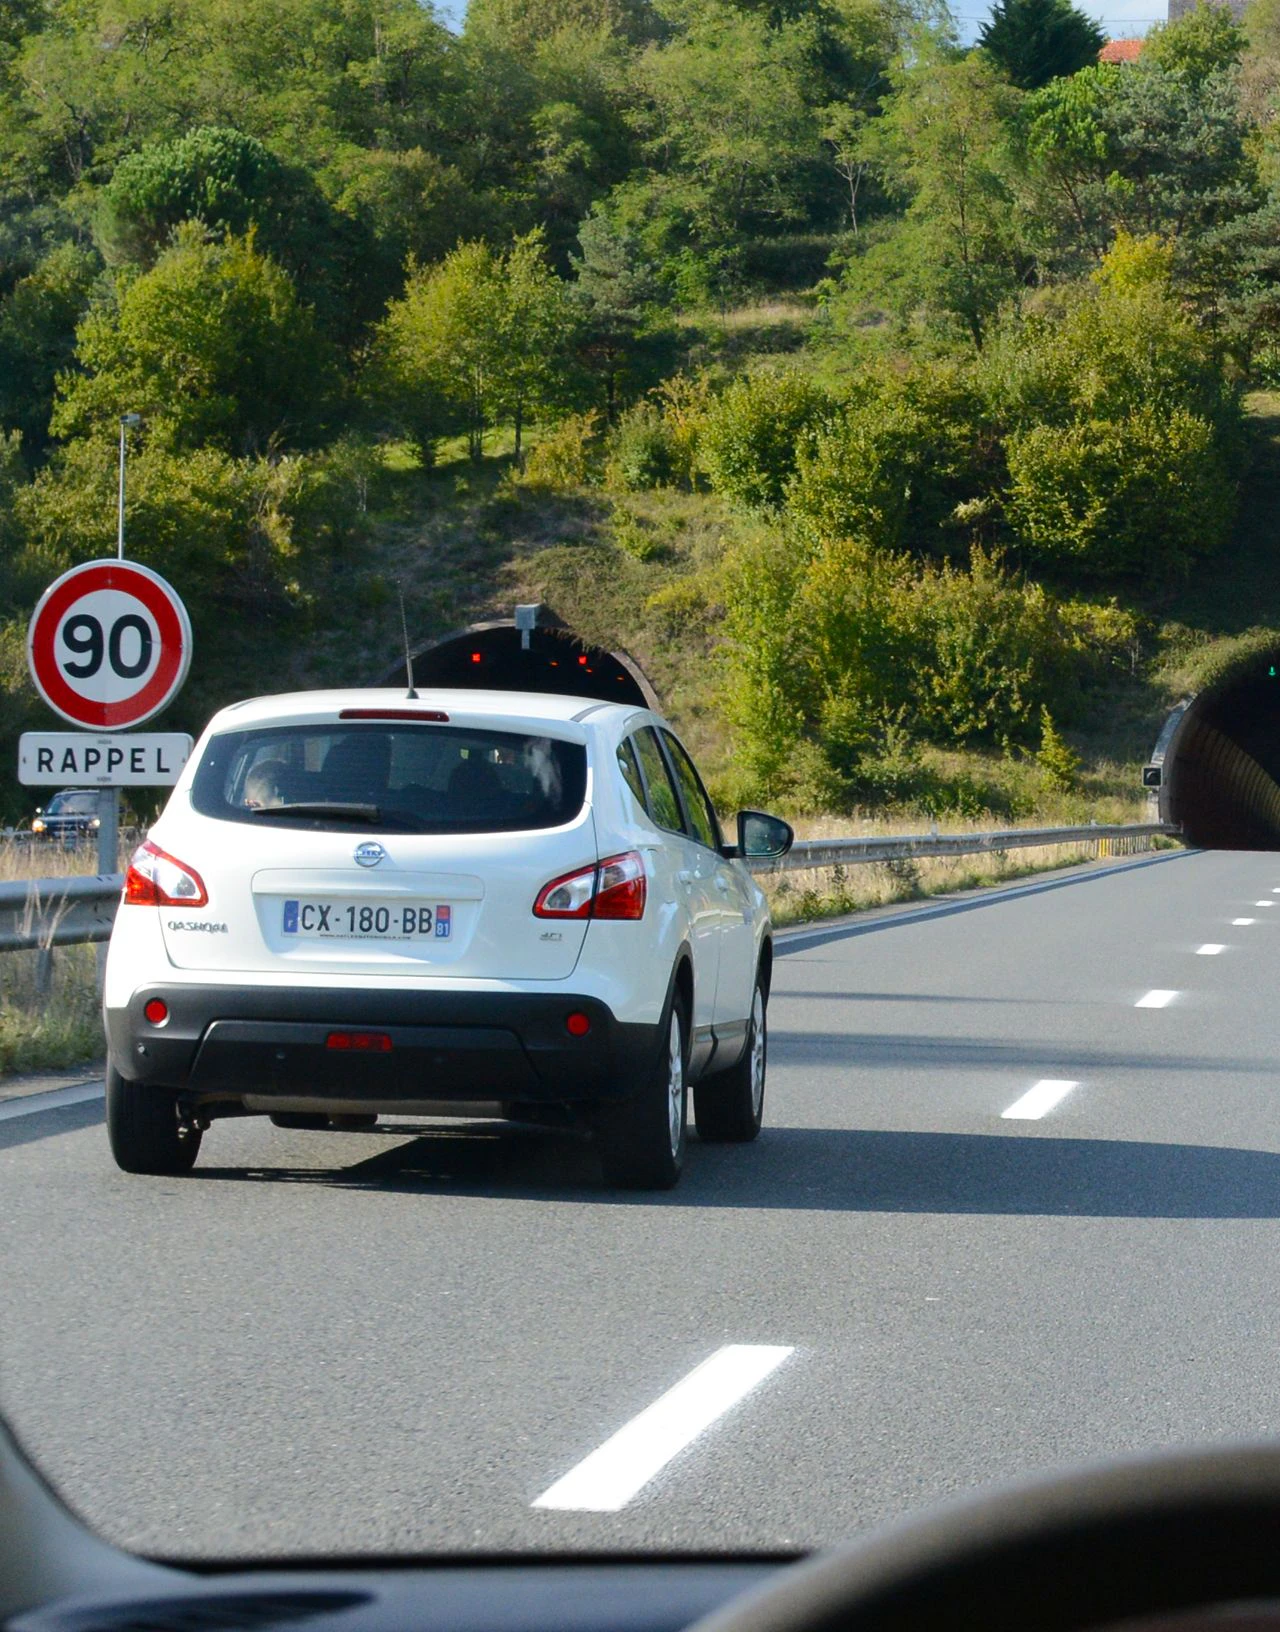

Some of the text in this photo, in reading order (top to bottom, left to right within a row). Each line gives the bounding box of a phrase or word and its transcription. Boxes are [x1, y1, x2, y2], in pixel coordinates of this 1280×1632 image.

[62, 613, 153, 679] 90
[37, 747, 171, 773] RAPPEL
[301, 904, 433, 934] CX-180-BB
[436, 922, 449, 936] 81
